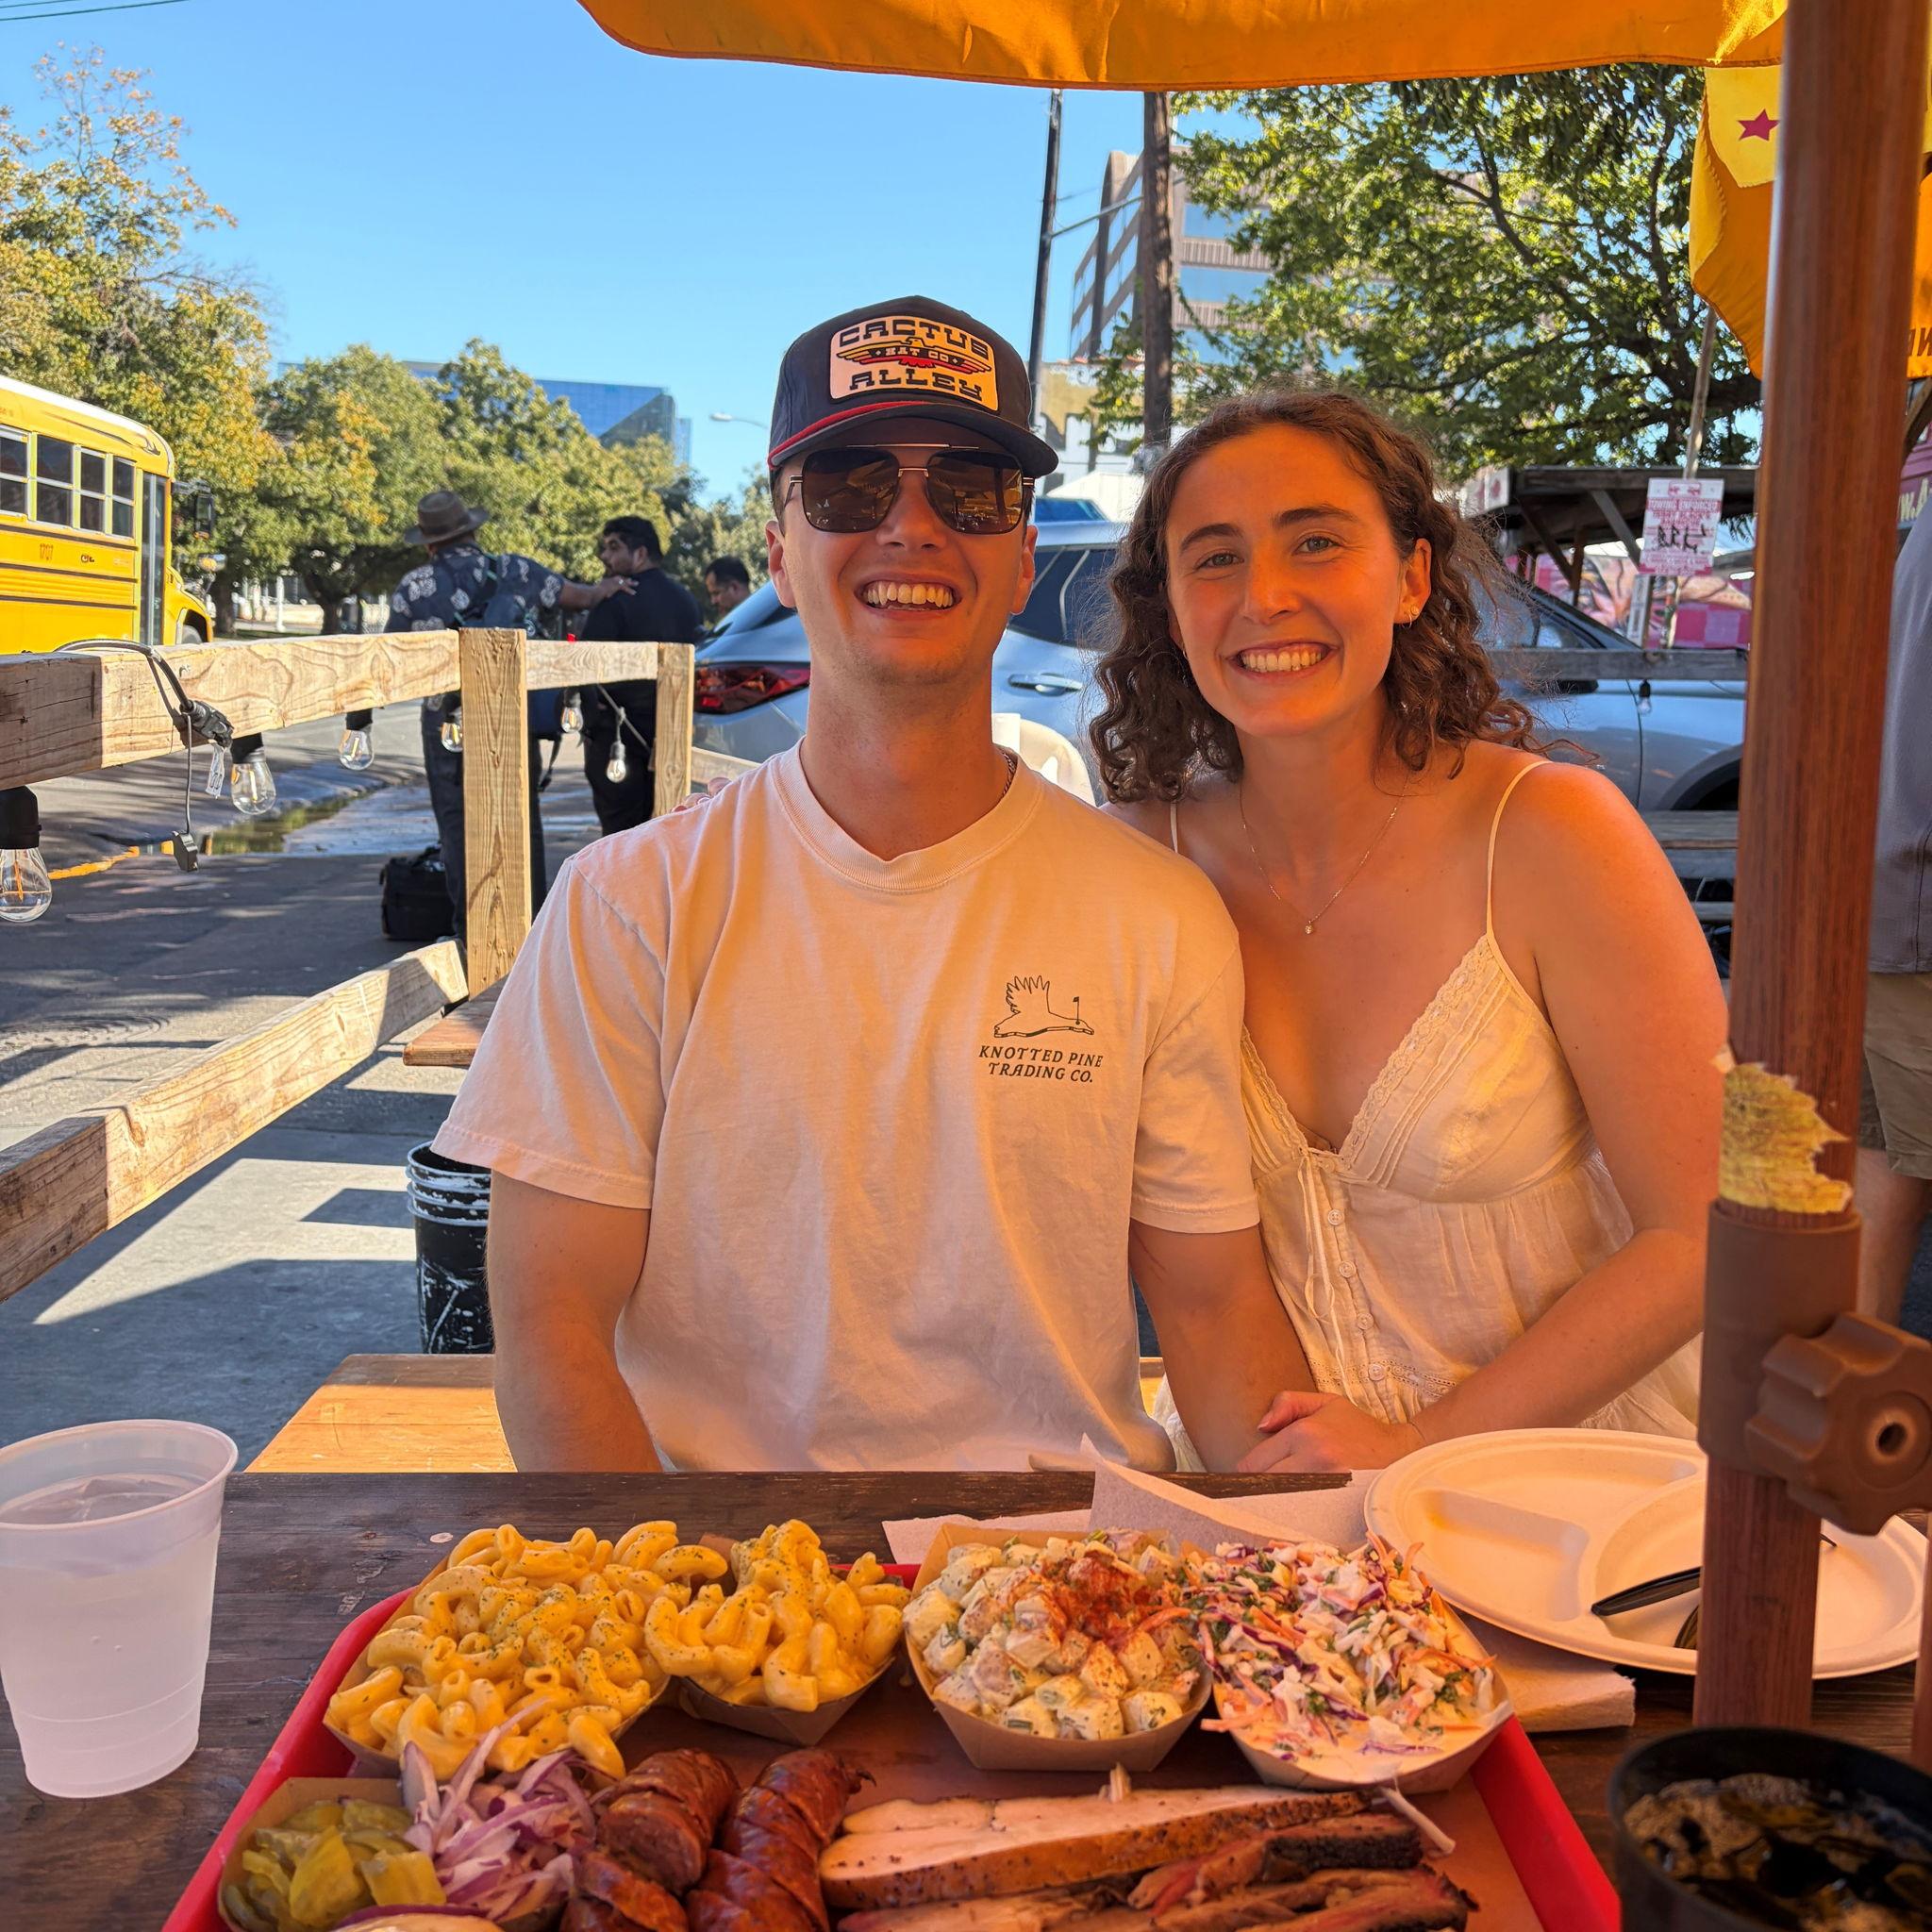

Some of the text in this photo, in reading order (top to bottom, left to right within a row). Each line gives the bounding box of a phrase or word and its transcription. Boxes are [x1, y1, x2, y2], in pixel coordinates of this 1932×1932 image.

[839, 319, 990, 359] CACTUS
[885, 346, 950, 361] HAT CO
[850, 368, 983, 402] ALLEY
[979, 1045, 1104, 1068] KNOTTED PINE
[989, 1062, 1093, 1083] TRADING CO.
